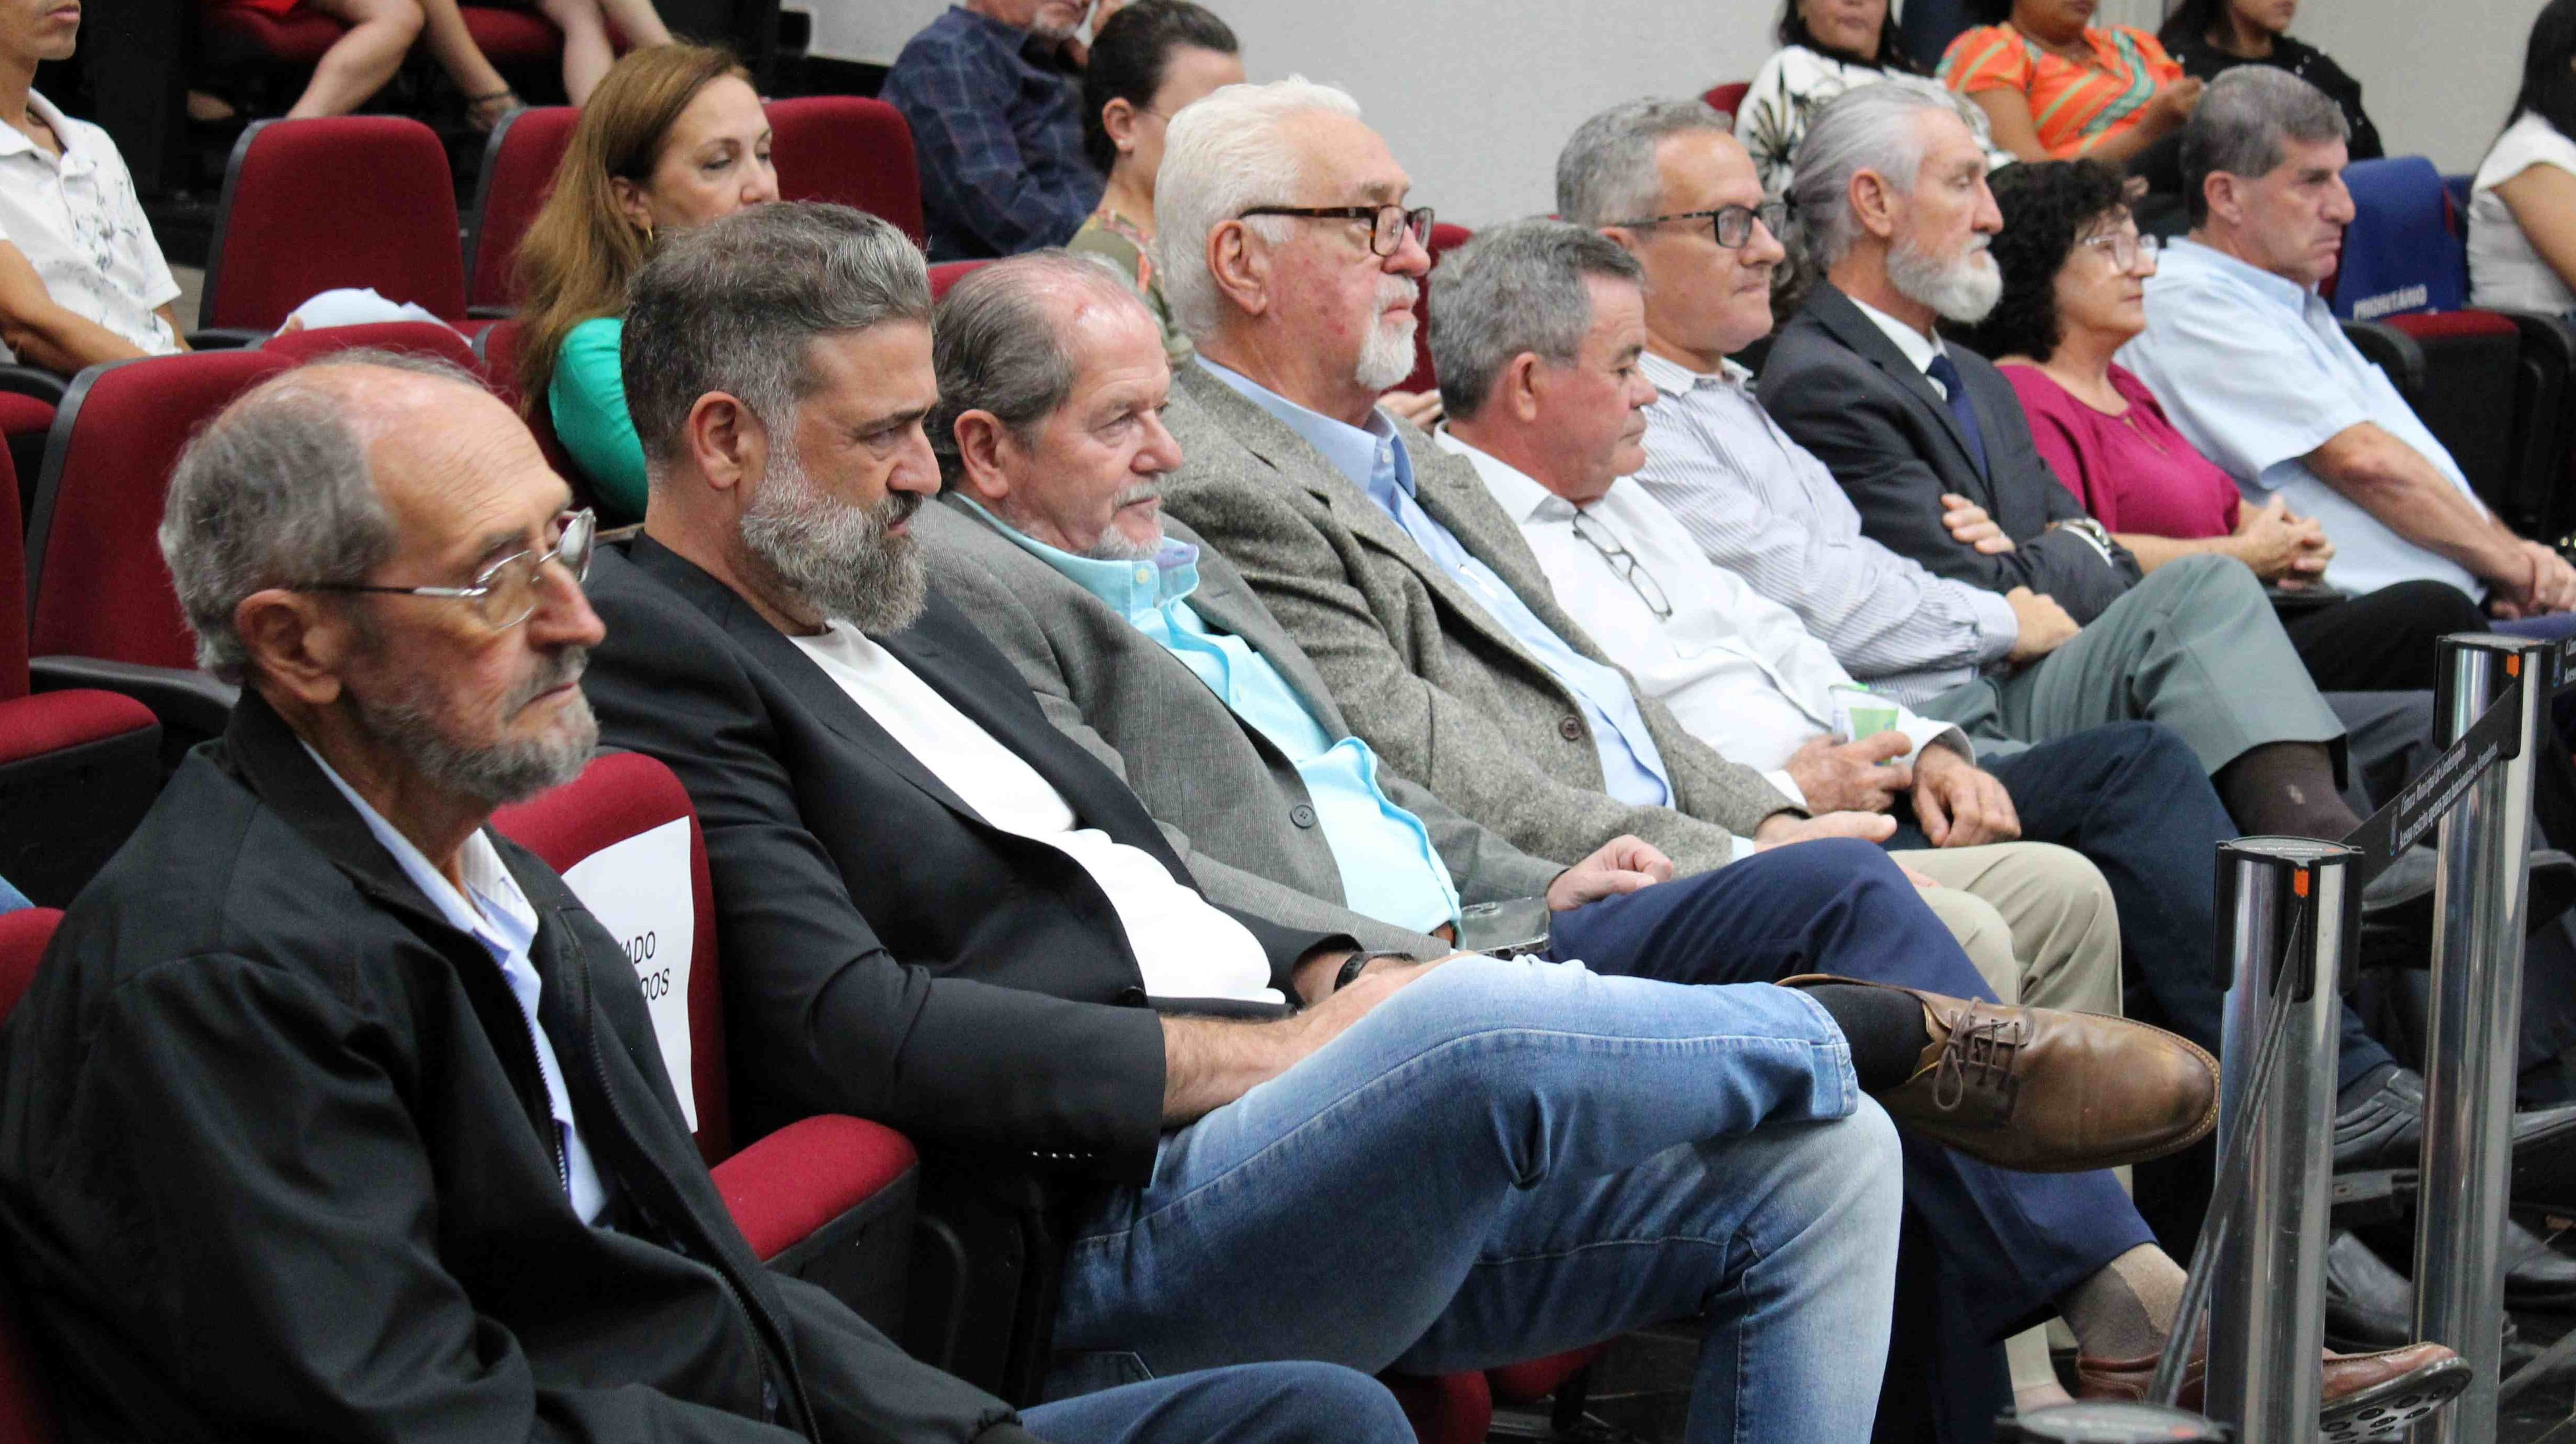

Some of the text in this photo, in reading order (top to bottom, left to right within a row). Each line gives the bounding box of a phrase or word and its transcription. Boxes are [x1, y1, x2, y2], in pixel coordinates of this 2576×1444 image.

[2399, 830, 2413, 851] Acesso
[2413, 810, 2428, 839] restrito
[2442, 788, 2451, 814] para
[620, 930, 655, 964] ADO
[640, 967, 670, 1000] DOS
